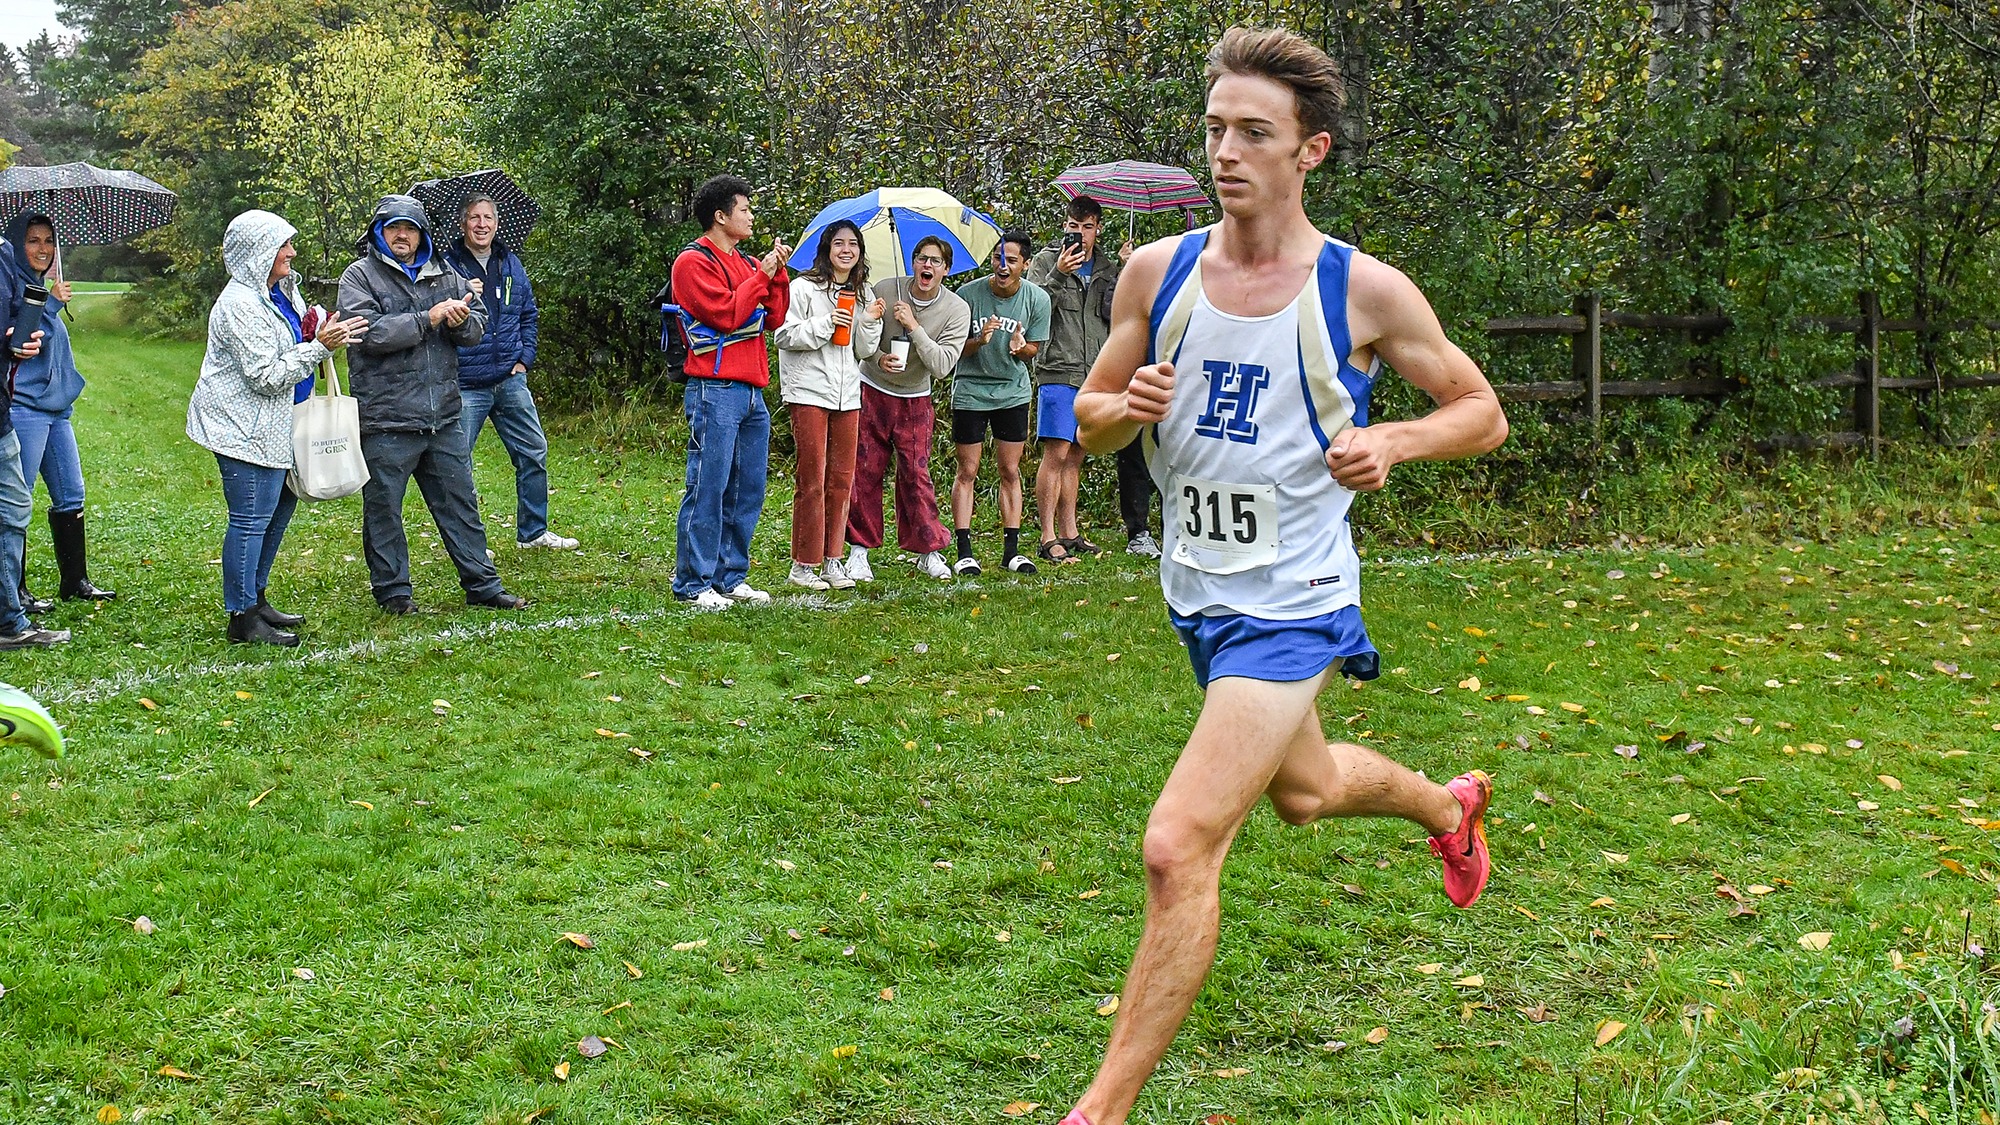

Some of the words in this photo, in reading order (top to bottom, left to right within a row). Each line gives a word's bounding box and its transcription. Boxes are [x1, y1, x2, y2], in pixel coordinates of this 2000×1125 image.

[972, 316, 1026, 336] BOTO
[1194, 359, 1271, 446] H
[1183, 485, 1257, 544] 315
